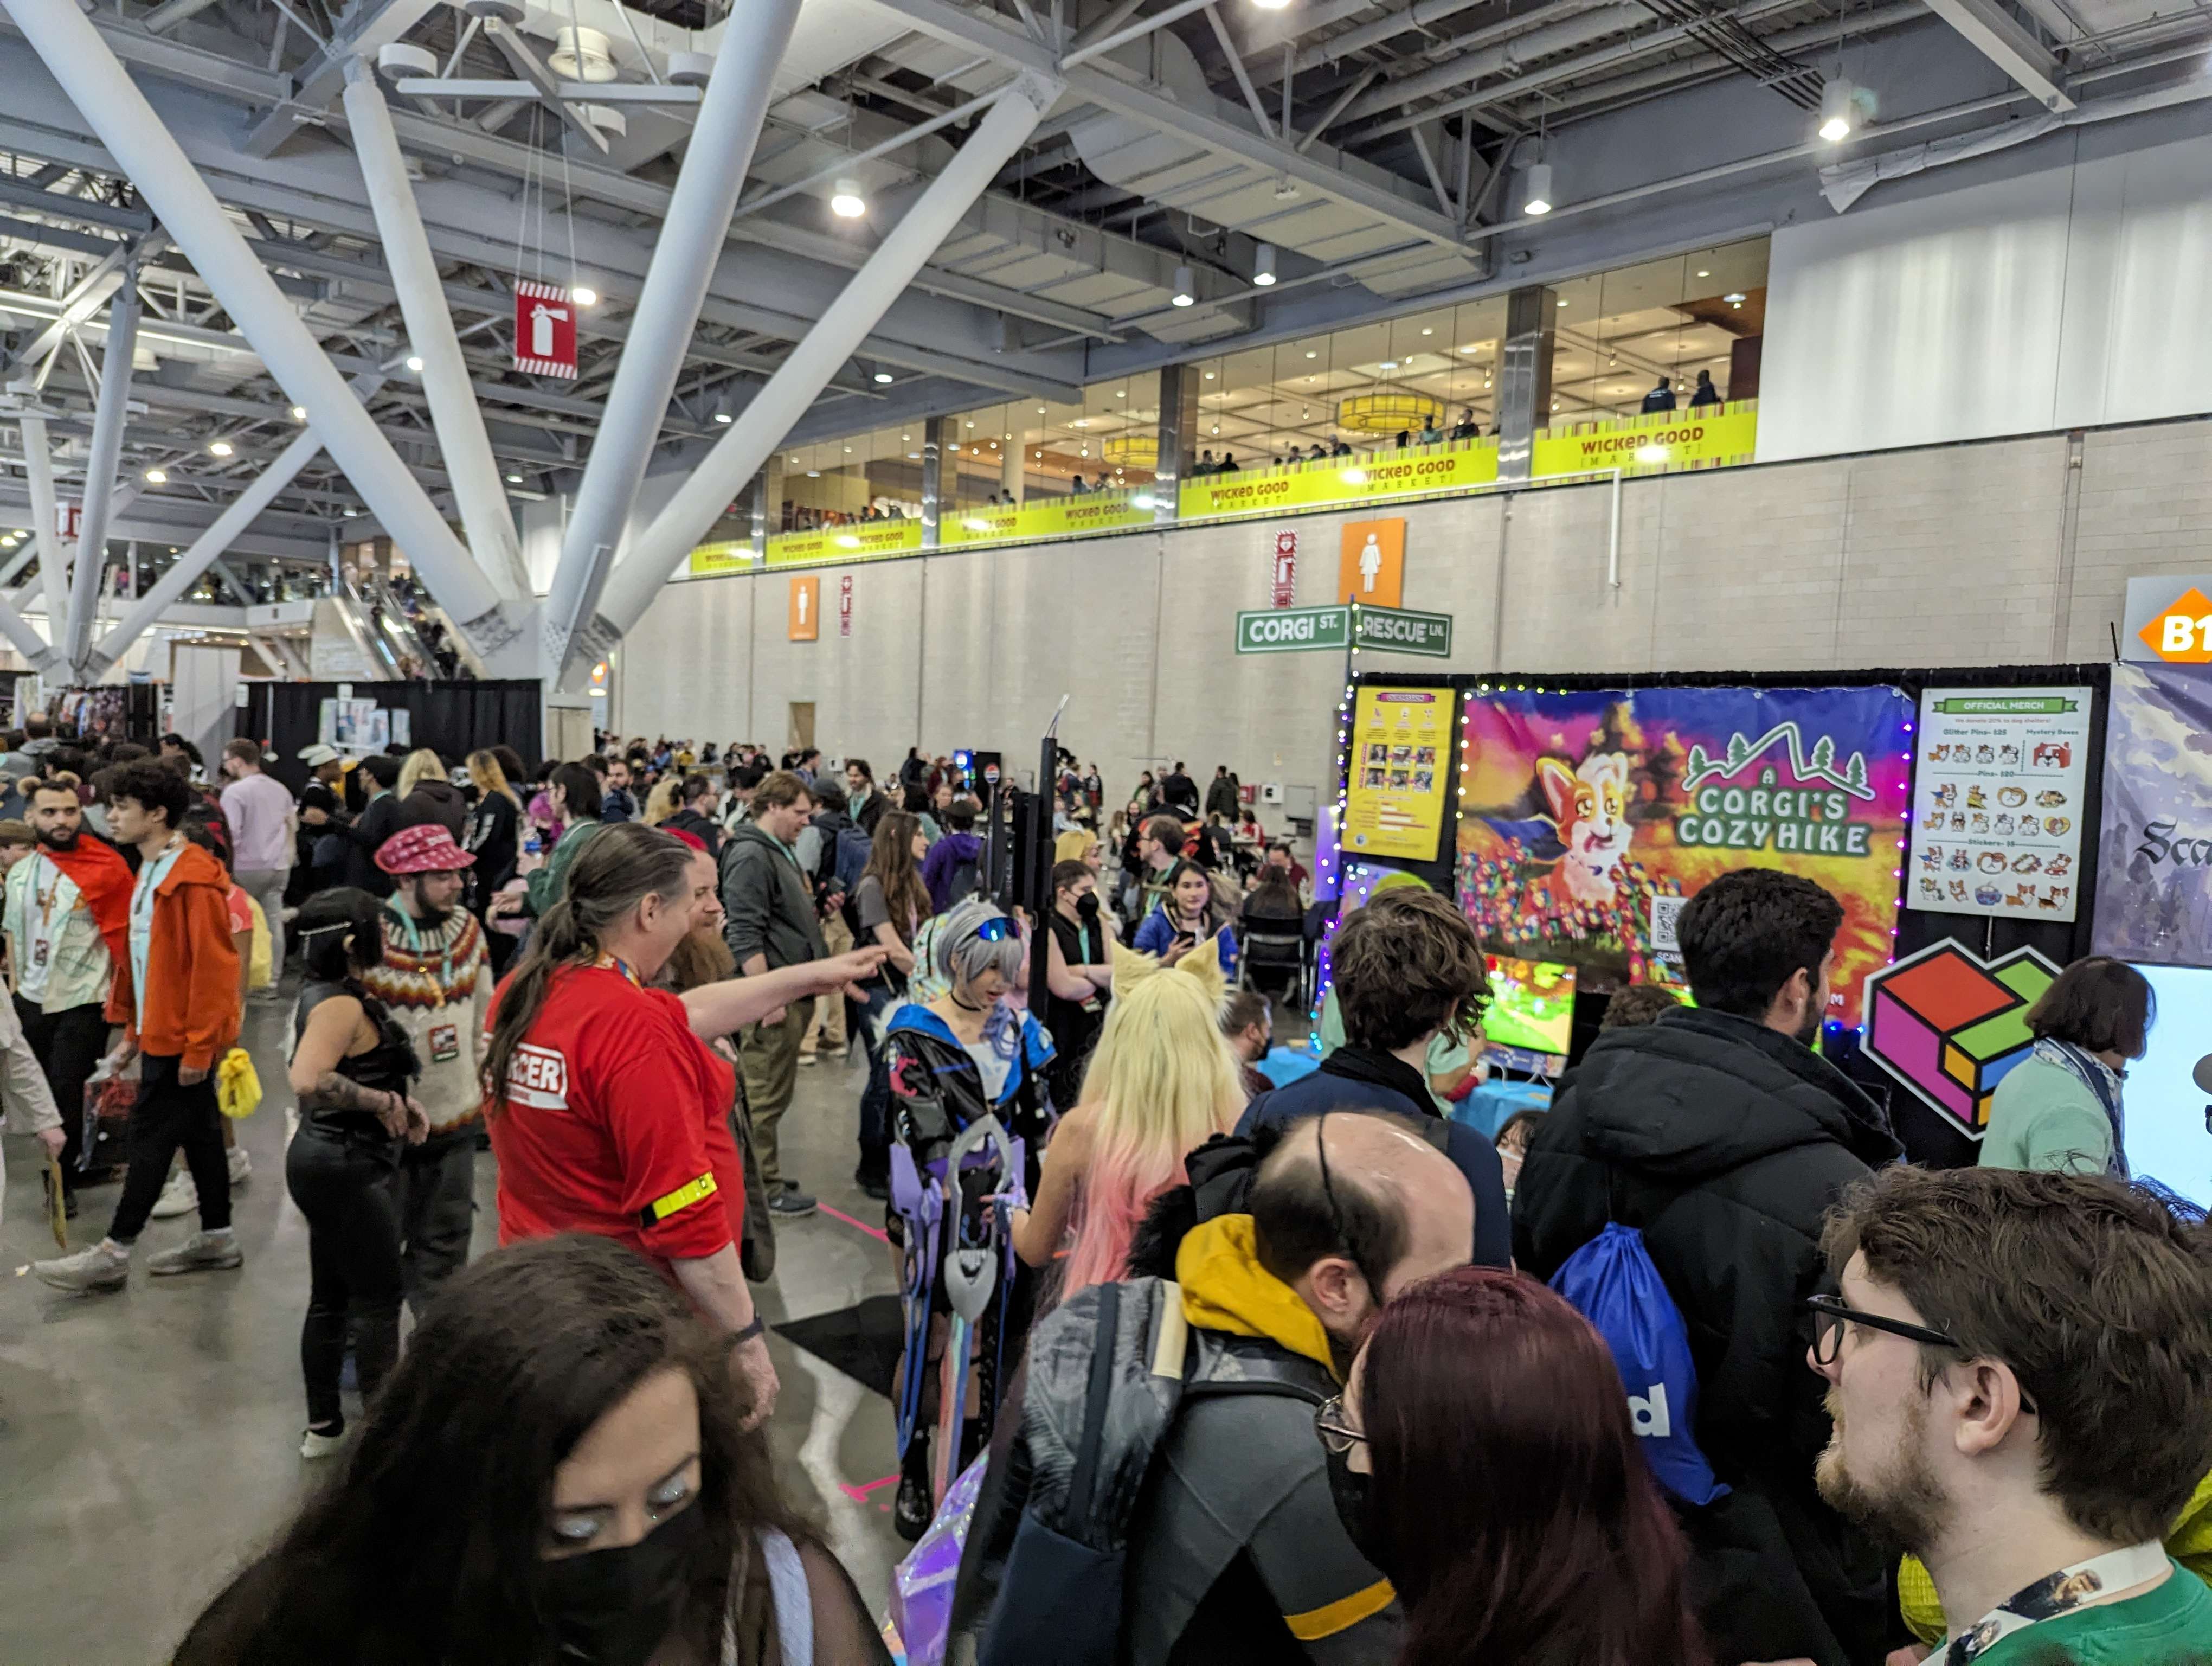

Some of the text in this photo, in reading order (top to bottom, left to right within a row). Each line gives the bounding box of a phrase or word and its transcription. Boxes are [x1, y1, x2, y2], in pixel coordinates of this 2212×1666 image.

[1654, 427, 1705, 445] GOOD
[1417, 459, 1455, 475] GOOD
[1257, 481, 1289, 495] GOOD
[1103, 503, 1129, 515] GOOD
[1249, 615, 1338, 643] CORGI ST.
[1363, 616, 1428, 643] RESCUE
[1964, 702, 2008, 710] OFFICIAL
[1762, 772, 1774, 785] A
[1700, 790, 1844, 820] CORGI'S
[1679, 817, 1869, 854] COZY HIKE
